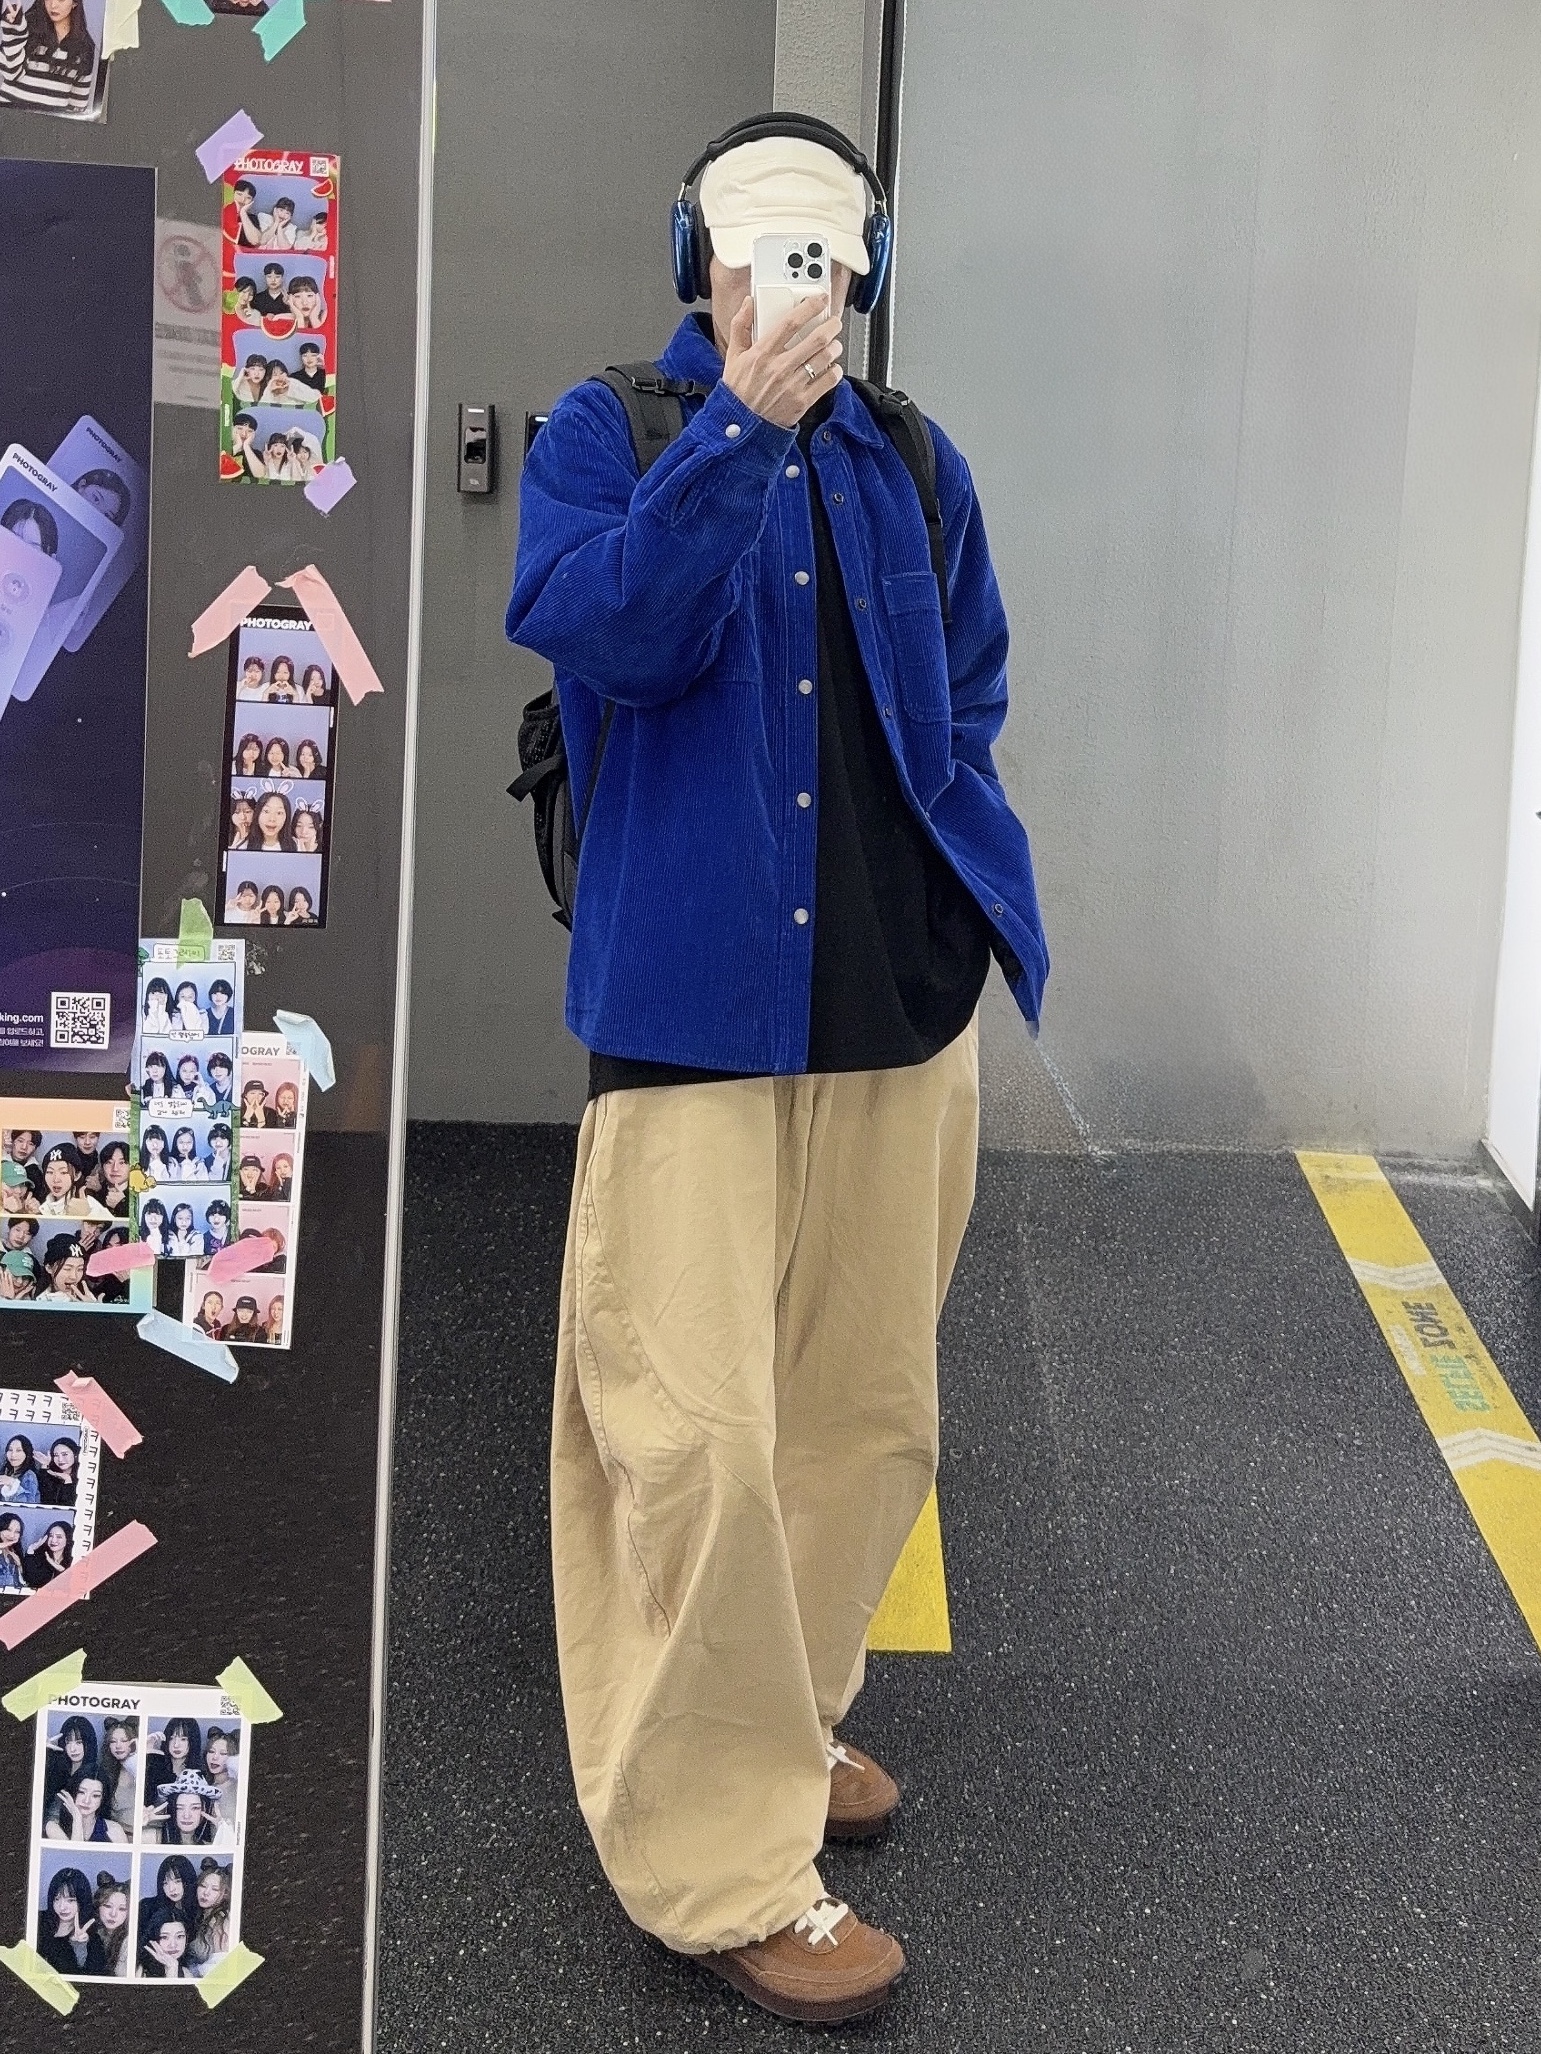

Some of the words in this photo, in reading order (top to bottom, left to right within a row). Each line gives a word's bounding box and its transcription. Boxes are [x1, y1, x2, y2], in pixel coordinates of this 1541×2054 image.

[235, 158, 304, 172] PHOTOGRAY
[86, 426, 122, 463] PHOTOGRAY
[12, 452, 58, 492] PHOTOGRAY
[240, 617, 314, 631] PHOTOGRAY
[48, 1694, 141, 1710] PHOTOGRAY
